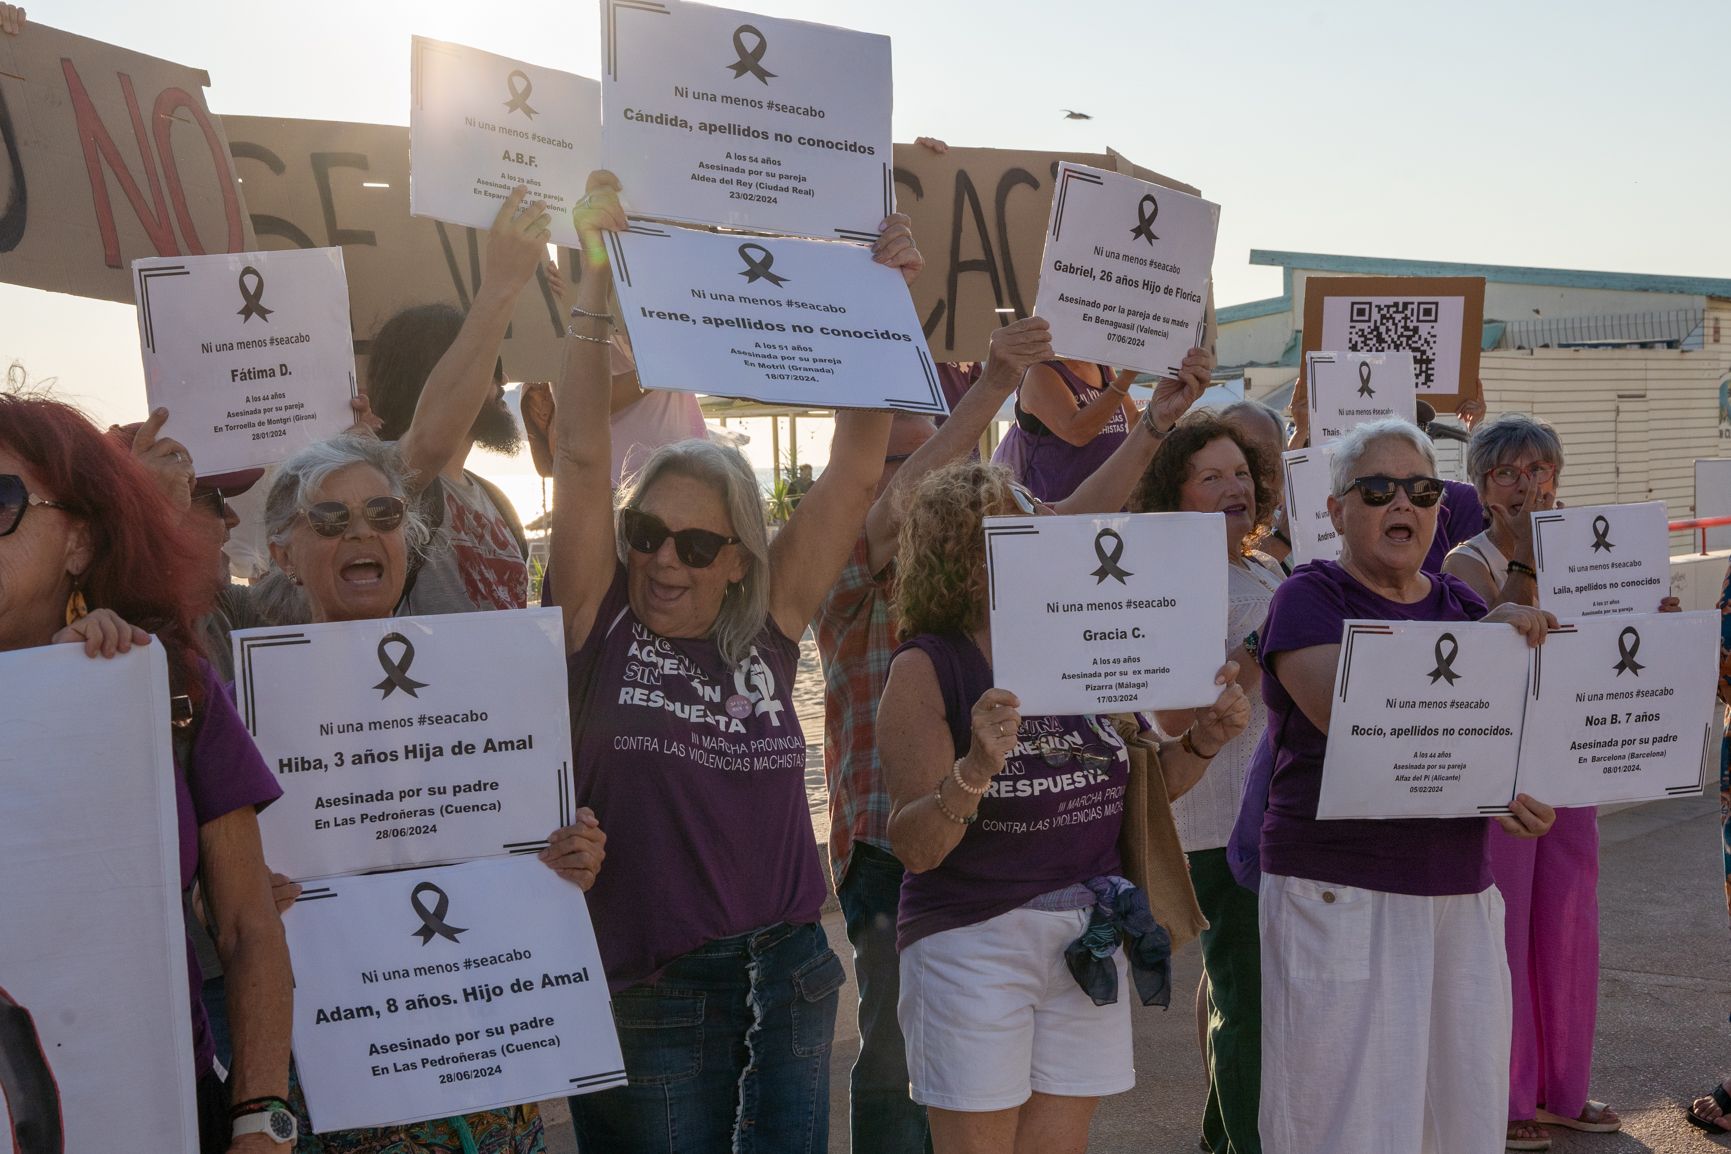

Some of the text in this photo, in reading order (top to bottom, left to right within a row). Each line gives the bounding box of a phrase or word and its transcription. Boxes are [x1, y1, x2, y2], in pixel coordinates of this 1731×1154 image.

[674, 86, 825, 119] Ni una menos #seacabo
[623, 108, 875, 156] Cándida, apellidos no conocidos
[61, 57, 244, 269] NO
[502, 149, 538, 168] A.B.F.
[698, 161, 746, 174] Asesinada
[748, 169, 763, 177] por
[778, 173, 807, 183] pareja
[691, 173, 815, 198] Aldea del Rey (Ciudad Real)
[729, 191, 778, 205] 23/02/2024
[1093, 245, 1181, 275] Ni una menos #seacabo
[1054, 260, 1201, 304] Gabriel, 26 años Hijo de Florica
[1058, 293, 1189, 329] Asesinado por la pareja de su madre
[640, 307, 912, 342] Irene, apellidos no conocidos
[1082, 313, 1169, 340] En Benaguasil (Valencia)
[201, 332, 310, 354] Ni una menos #seacabo
[1107, 332, 1145, 347] 07/06/2024
[230, 363, 292, 383] Fátima D.
[743, 359, 756, 367] En
[757, 362, 786, 370] Motril
[213, 425, 224, 433] En
[224, 421, 256, 432] Torroella
[257, 419, 266, 427] de
[1046, 596, 1176, 613] Ni una menos #seacabo
[1083, 627, 1145, 642] Gracia C.
[1061, 670, 1102, 680] Asesinada
[1104, 671, 1117, 679] por
[1143, 666, 1170, 675] marido
[1115, 680, 1148, 691] (Málaga)
[1097, 693, 1138, 703] 17/03/2024
[320, 709, 488, 736] Ni una menos #seacabo
[1585, 711, 1660, 727] Noa B. 7 años
[1389, 725, 1439, 739] apellidos
[1570, 733, 1678, 751] Asesinada por su padre
[278, 734, 533, 774] Hiba, 3 años Hija de Amal
[613, 735, 806, 772] CONTRA LAS VIOLENCIAS MACHISTAS
[1578, 756, 1588, 764] En
[1591, 754, 1626, 763] Barcelona
[983, 768, 1110, 798] RESPUESTA
[314, 780, 499, 810] Asesinada por su padre
[315, 800, 502, 830] En Las Pedroñeras (Cuenca)
[982, 819, 1027, 834] CONTRA
[1030, 818, 1050, 832] LAS
[376, 824, 438, 840] 28/06/2024
[361, 948, 532, 984] Ni una menos #seacabo
[315, 967, 590, 1025] Adam, 8 años. Hijo de Amal
[369, 1016, 554, 1056] Asesinado por su padre
[371, 1035, 560, 1077] En Las Pedroñeras (Cuenca)
[438, 1064, 502, 1084] 28/06/2024
